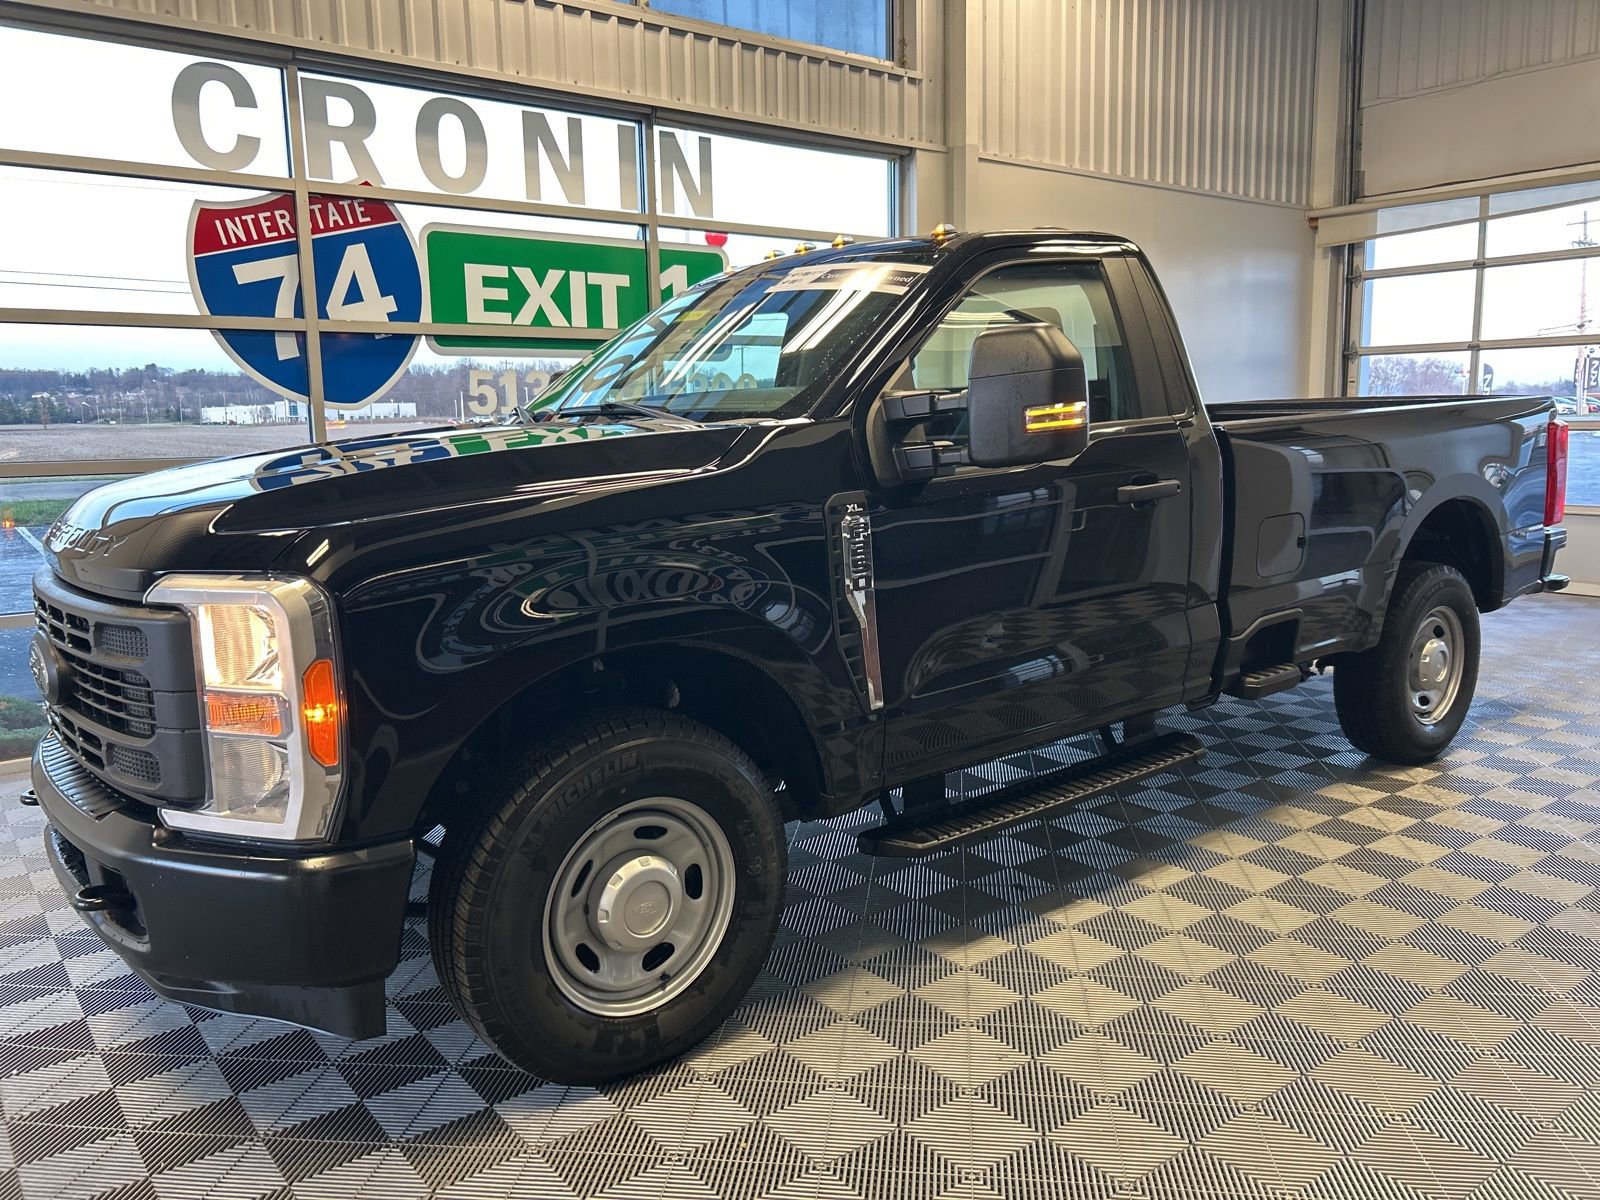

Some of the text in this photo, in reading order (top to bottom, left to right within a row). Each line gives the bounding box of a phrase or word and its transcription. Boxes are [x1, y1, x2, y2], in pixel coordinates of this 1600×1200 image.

[172, 62, 714, 218] CRONIN
[215, 199, 372, 246] INTERTATE
[232, 243, 398, 361] 74
[464, 263, 630, 329] EXIT
[846, 503, 864, 513] XL
